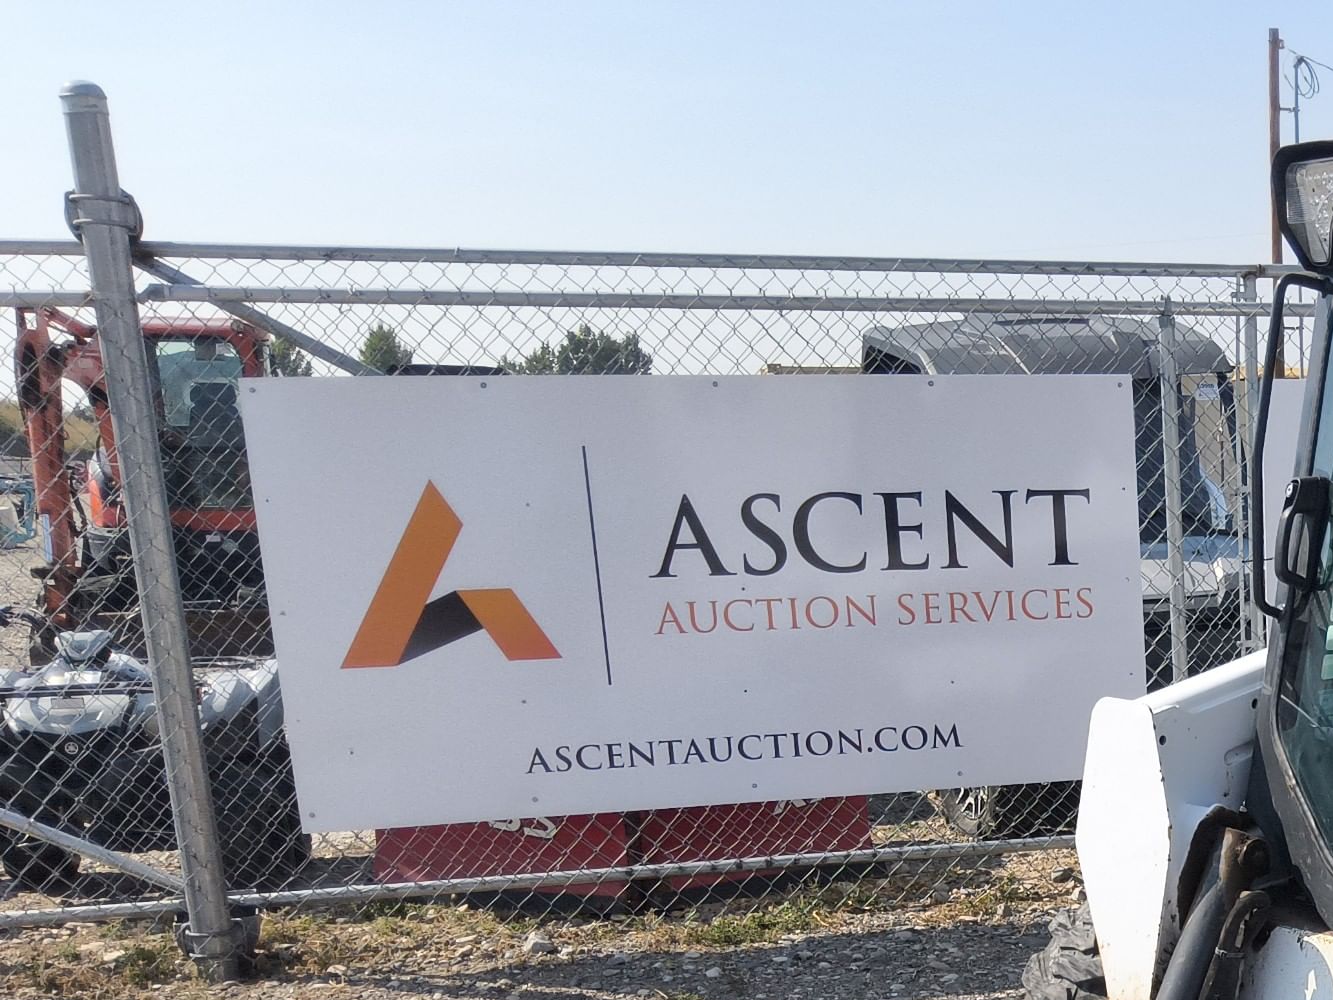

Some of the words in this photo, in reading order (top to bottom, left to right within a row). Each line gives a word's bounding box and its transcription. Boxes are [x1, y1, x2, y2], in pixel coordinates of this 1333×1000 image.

[648, 487, 1091, 579] ASCENT
[654, 595, 877, 635] AUCTION
[897, 587, 1094, 626] SERVICES
[525, 723, 964, 774] ASCENTAUCTION.COM
